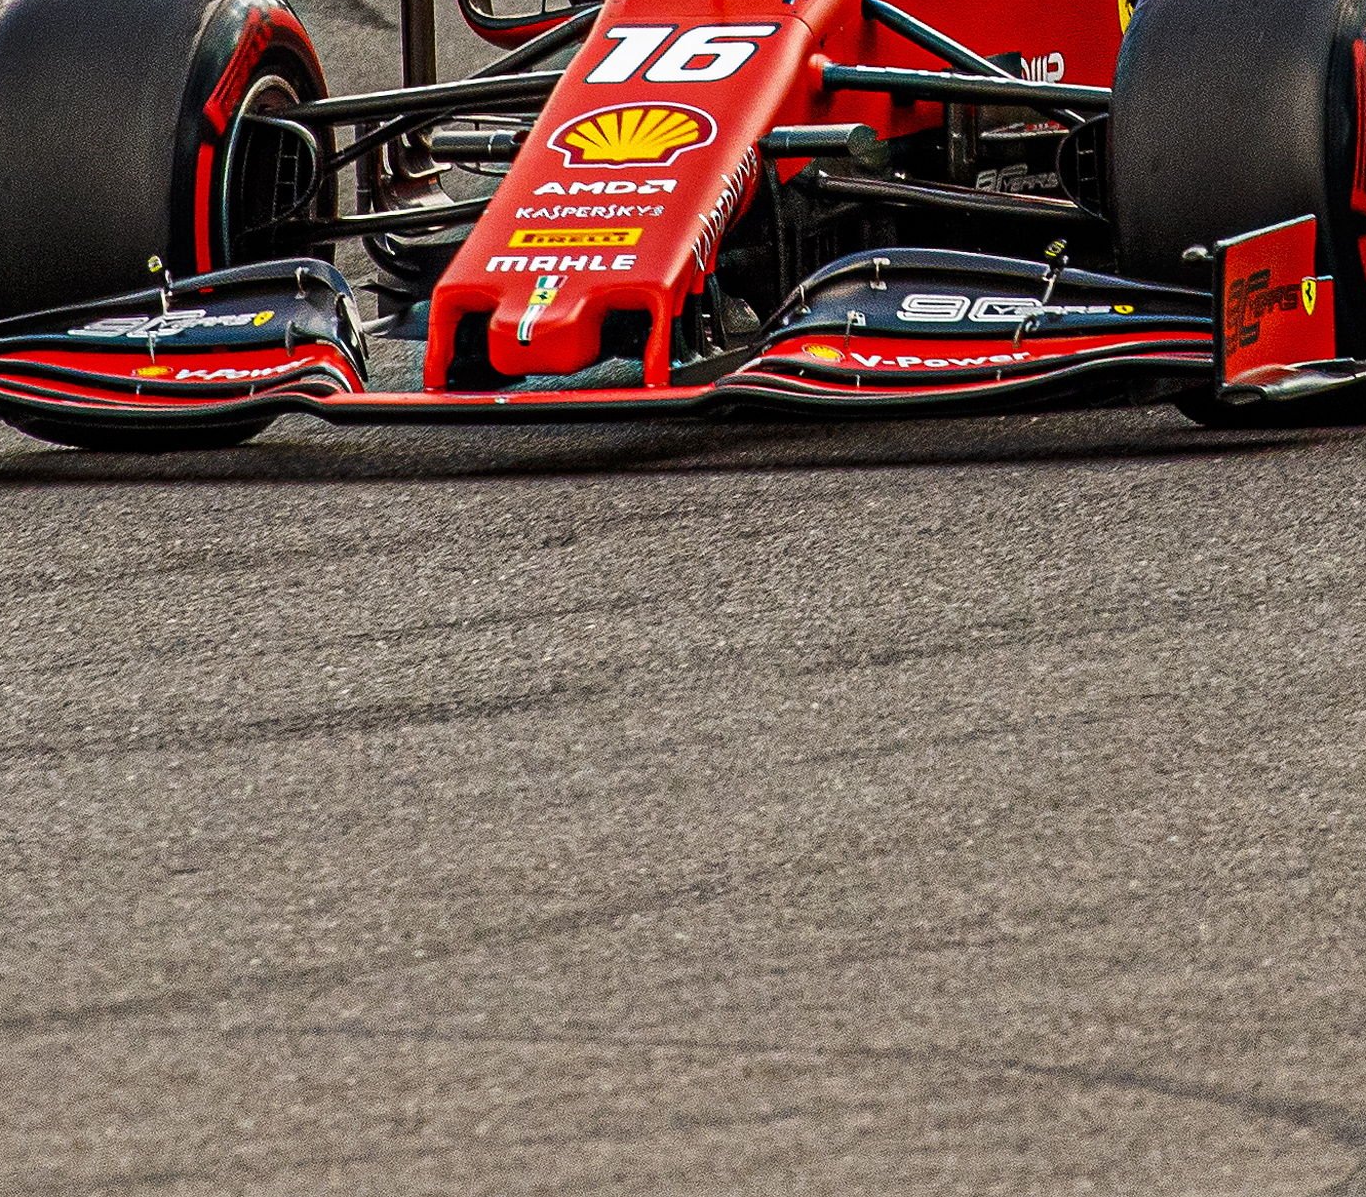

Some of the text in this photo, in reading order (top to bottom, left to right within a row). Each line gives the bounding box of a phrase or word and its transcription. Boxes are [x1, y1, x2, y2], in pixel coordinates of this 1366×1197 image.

[584, 22, 781, 84] 16
[485, 255, 638, 273] MAHLE
[896, 293, 1044, 322] 90
[850, 350, 1032, 368] V-Power
